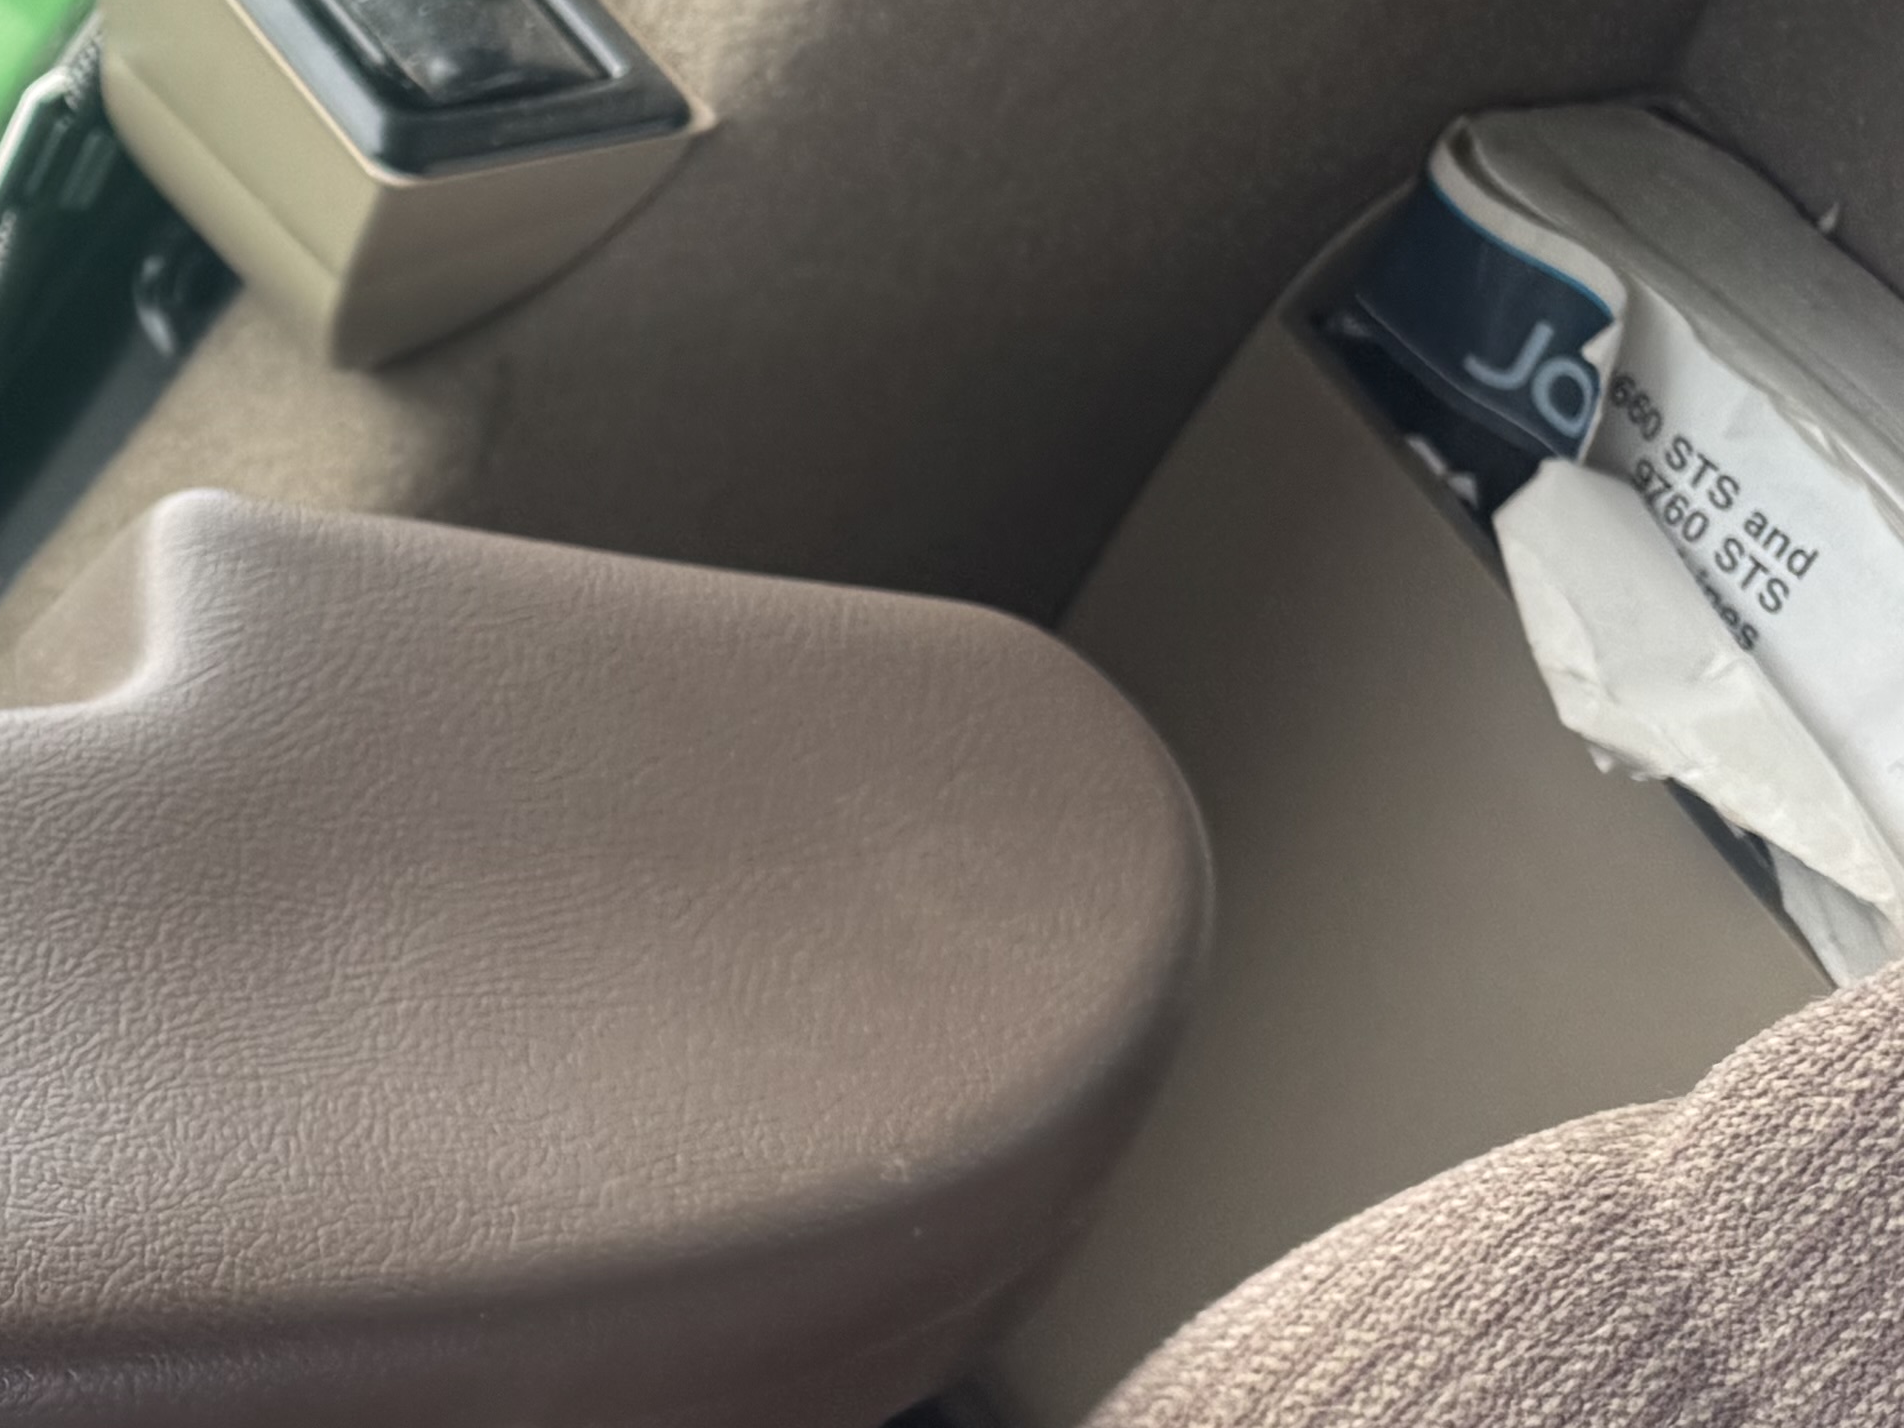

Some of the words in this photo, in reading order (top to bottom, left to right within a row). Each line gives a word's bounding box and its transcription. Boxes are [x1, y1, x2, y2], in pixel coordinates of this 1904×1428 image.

[1664, 433, 1740, 511] STS
[1744, 509, 1819, 579] and
[1714, 537, 1790, 615] STS
